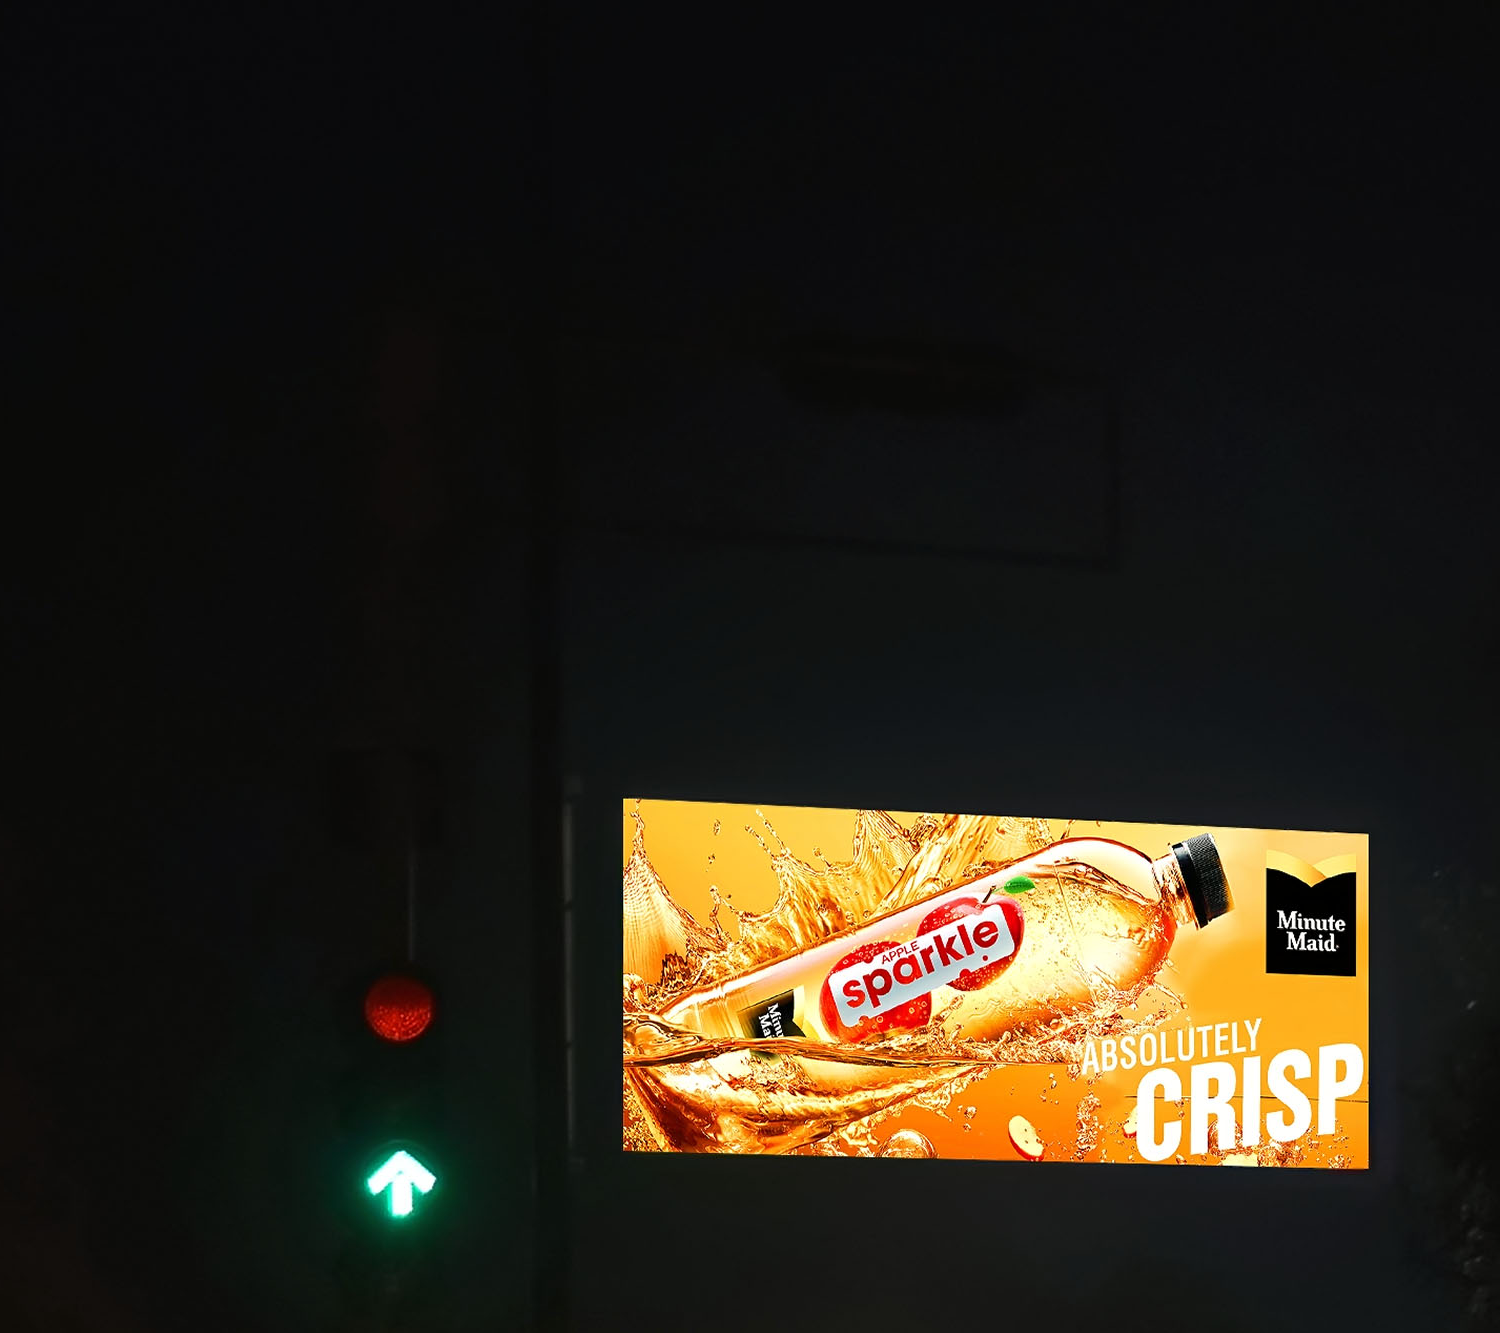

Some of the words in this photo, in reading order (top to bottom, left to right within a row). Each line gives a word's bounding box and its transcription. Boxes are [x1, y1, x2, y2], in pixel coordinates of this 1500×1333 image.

[1277, 909, 1346, 932] Minute
[881, 940, 920, 965] APPLE
[1286, 931, 1337, 952] Maid
[842, 920, 999, 1009] sparkle
[768, 1002, 785, 1038] Minu
[1080, 1018, 1262, 1076] ABSOLUTELY
[1136, 1042, 1364, 1162] CRISP
